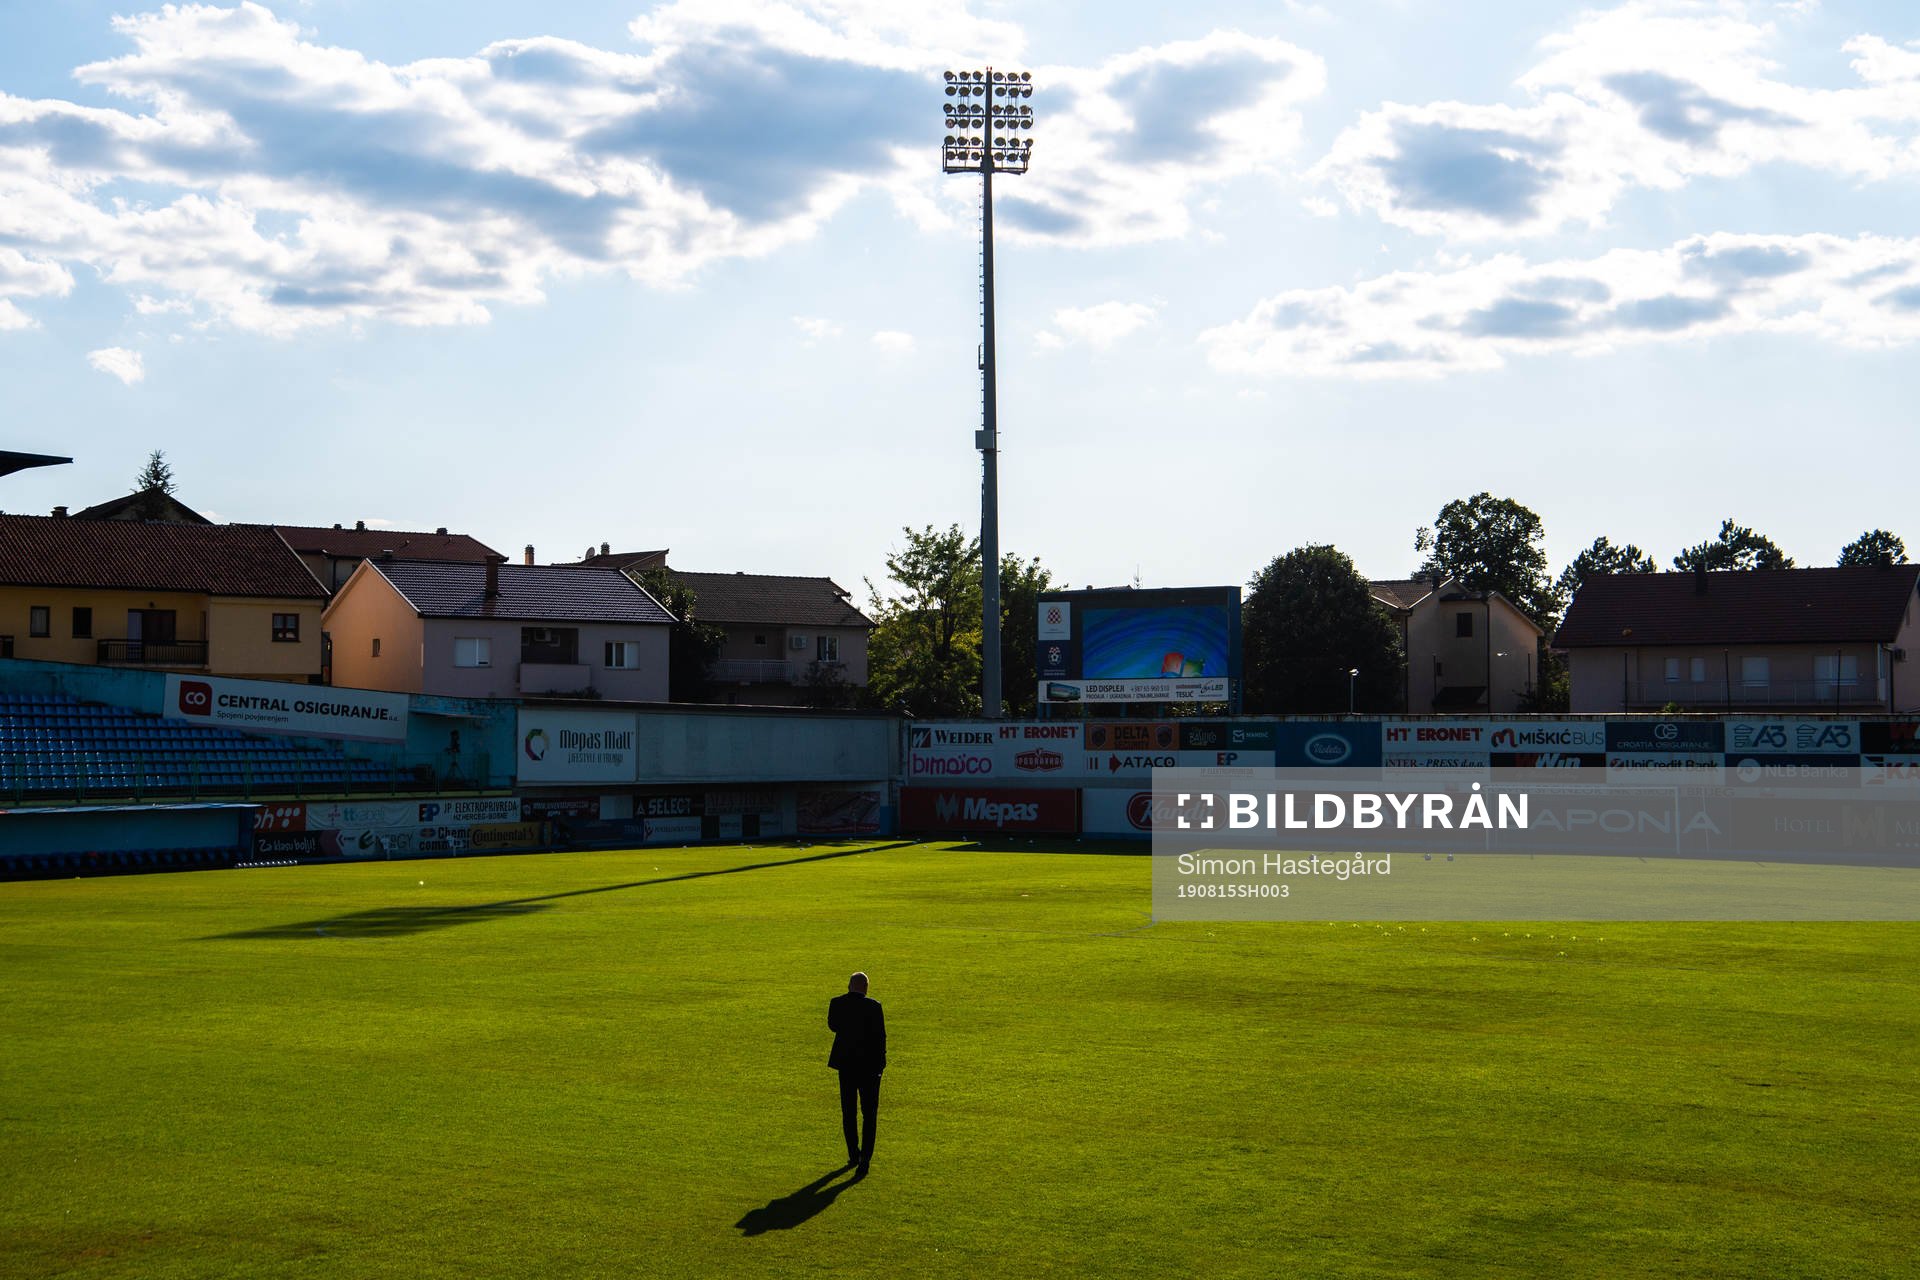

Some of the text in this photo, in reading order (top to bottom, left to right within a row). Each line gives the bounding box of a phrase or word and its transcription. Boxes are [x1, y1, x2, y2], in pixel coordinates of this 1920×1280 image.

[218, 694, 290, 712] CENTRAL
[294, 700, 389, 720] OSIGURANJE
[560, 730, 631, 751] Mepas Mall
[1000, 727, 1078, 738] HT ERONET
[1114, 726, 1150, 739] DELTA
[1386, 728, 1483, 741] HT ERONET
[1519, 728, 1604, 745] MIŠKIĆ BUS
[1752, 725, 1787, 748] A3
[1815, 725, 1851, 748] A3
[1123, 756, 1176, 768] ATACO
[1626, 759, 1719, 772] UniCredit Bank
[1801, 760, 1849, 778] Banka
[963, 798, 1039, 827] Mepas
[1504, 809, 1723, 834] APONIA
[473, 828, 527, 846] Continental
